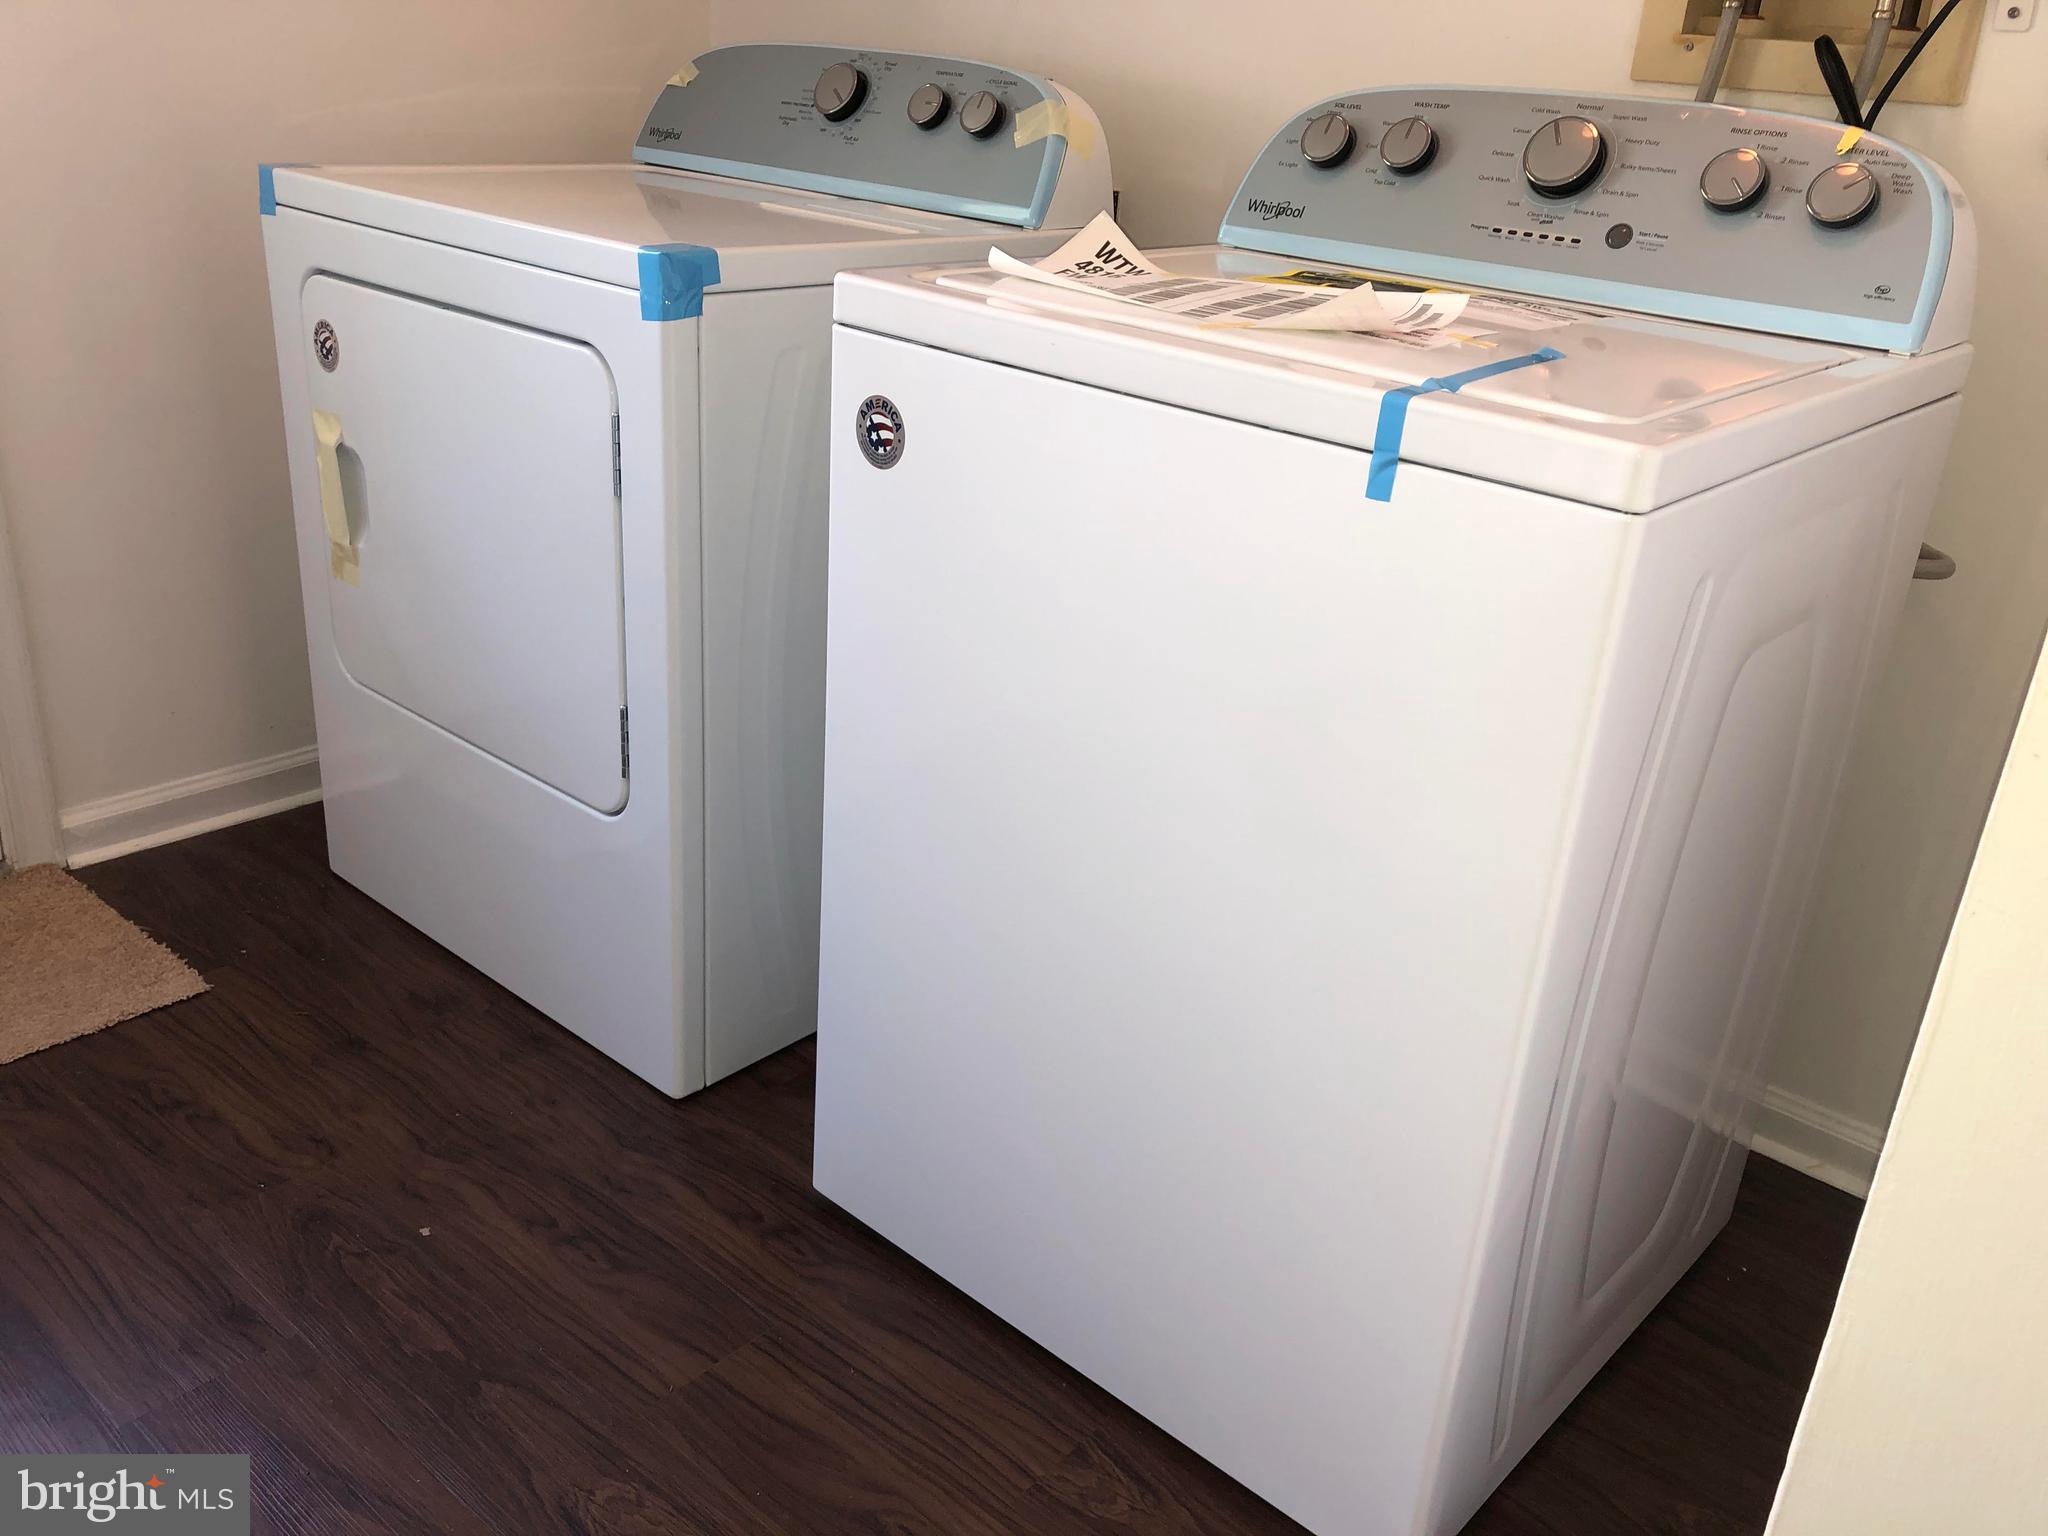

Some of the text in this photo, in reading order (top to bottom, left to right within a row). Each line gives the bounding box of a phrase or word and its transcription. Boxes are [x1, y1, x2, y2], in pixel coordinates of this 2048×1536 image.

[1414, 101, 1432, 109] WASH
[1576, 103, 1604, 111] Normal
[1730, 127, 1788, 138] RINSE OPTIONS
[1865, 149, 1889, 157] LEVEL
[1248, 198, 1306, 221] Whirlpool
[1094, 240, 1152, 276] WTW
[860, 398, 902, 433] AMERICA
